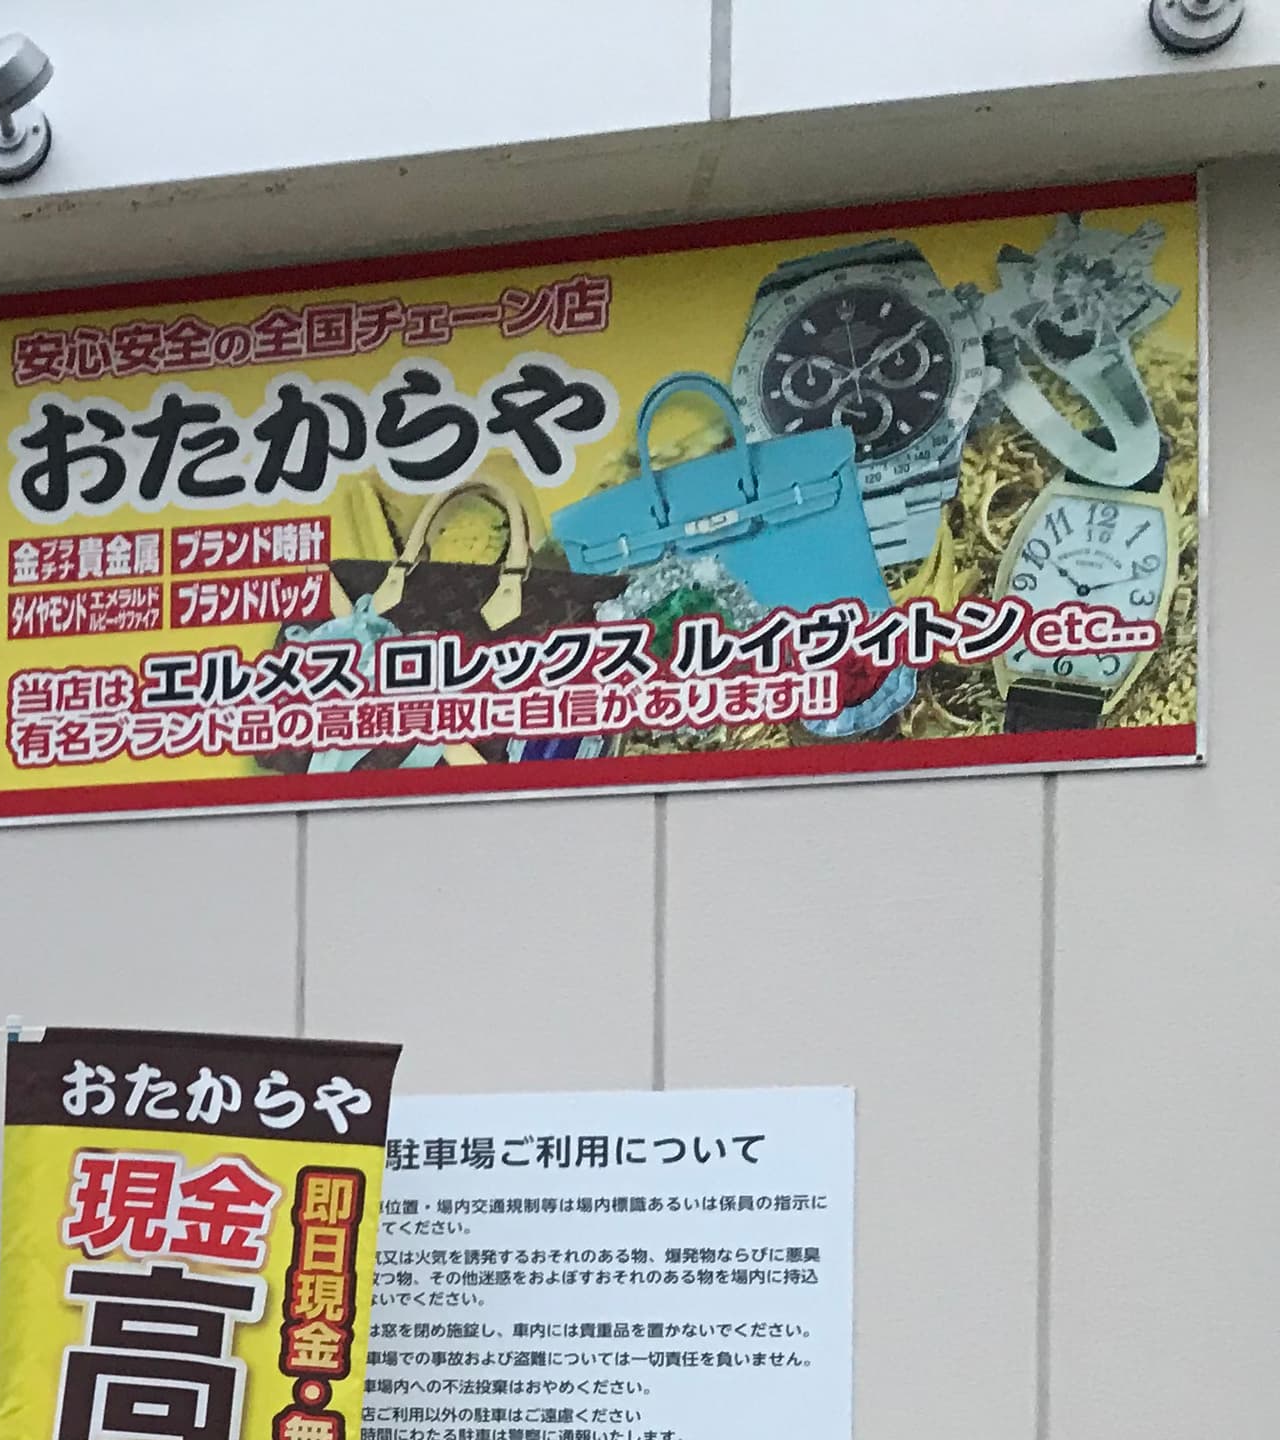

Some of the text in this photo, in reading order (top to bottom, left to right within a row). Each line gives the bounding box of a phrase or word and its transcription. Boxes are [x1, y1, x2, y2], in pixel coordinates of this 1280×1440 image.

[14, 276, 609, 383] 安心安全の全国チェーン店
[19, 364, 607, 512] おたからや
[178, 520, 325, 569] ブランド時計
[11, 596, 87, 635] ダイヤモンド
[91, 586, 159, 606] エメラルド
[178, 576, 323, 624] ブランドバッグ
[17, 675, 133, 714] 当店は
[146, 648, 357, 702] エルメス
[386, 629, 651, 688] ロレックス
[678, 604, 1018, 674] ルイヴィトン
[62, 1057, 372, 1137] おたからや
[386, 1134, 765, 1170] 駐車場ご利用について
[69, 1157, 278, 1260] 現金
[379, 1194, 828, 1215] 位置・場内交通規制等は場内標識あるいは係員の指示に
[382, 1220, 471, 1235] てください。
